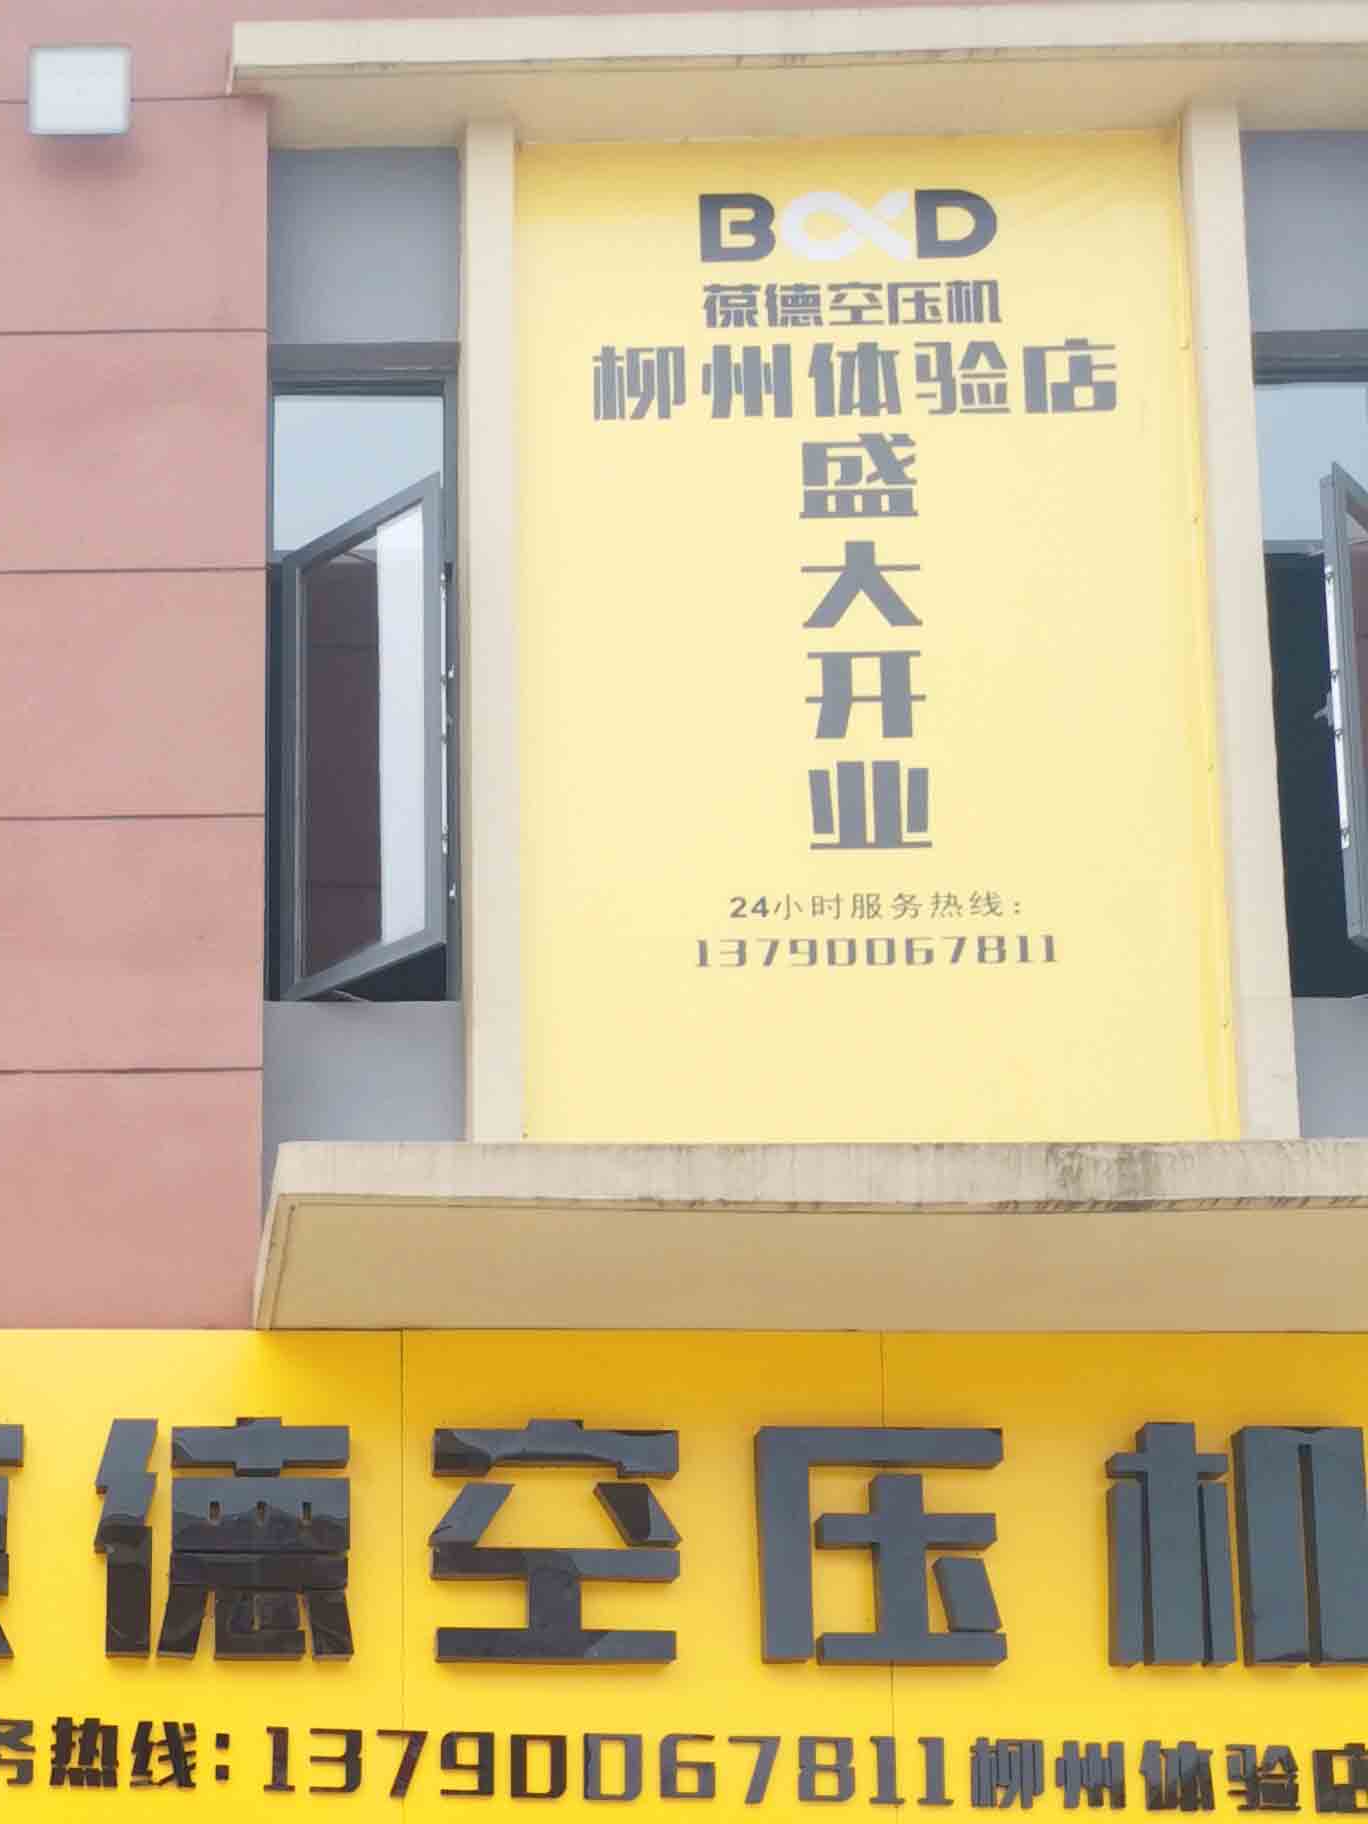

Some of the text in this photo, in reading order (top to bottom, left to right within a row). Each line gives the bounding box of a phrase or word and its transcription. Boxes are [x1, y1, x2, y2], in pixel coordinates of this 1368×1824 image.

[703, 279, 1001, 328] 葆德空压机
[592, 337, 1117, 421] 柳州体验店
[798, 432, 932, 850] 盛大开业
[694, 934, 1060, 968] 13790067811
